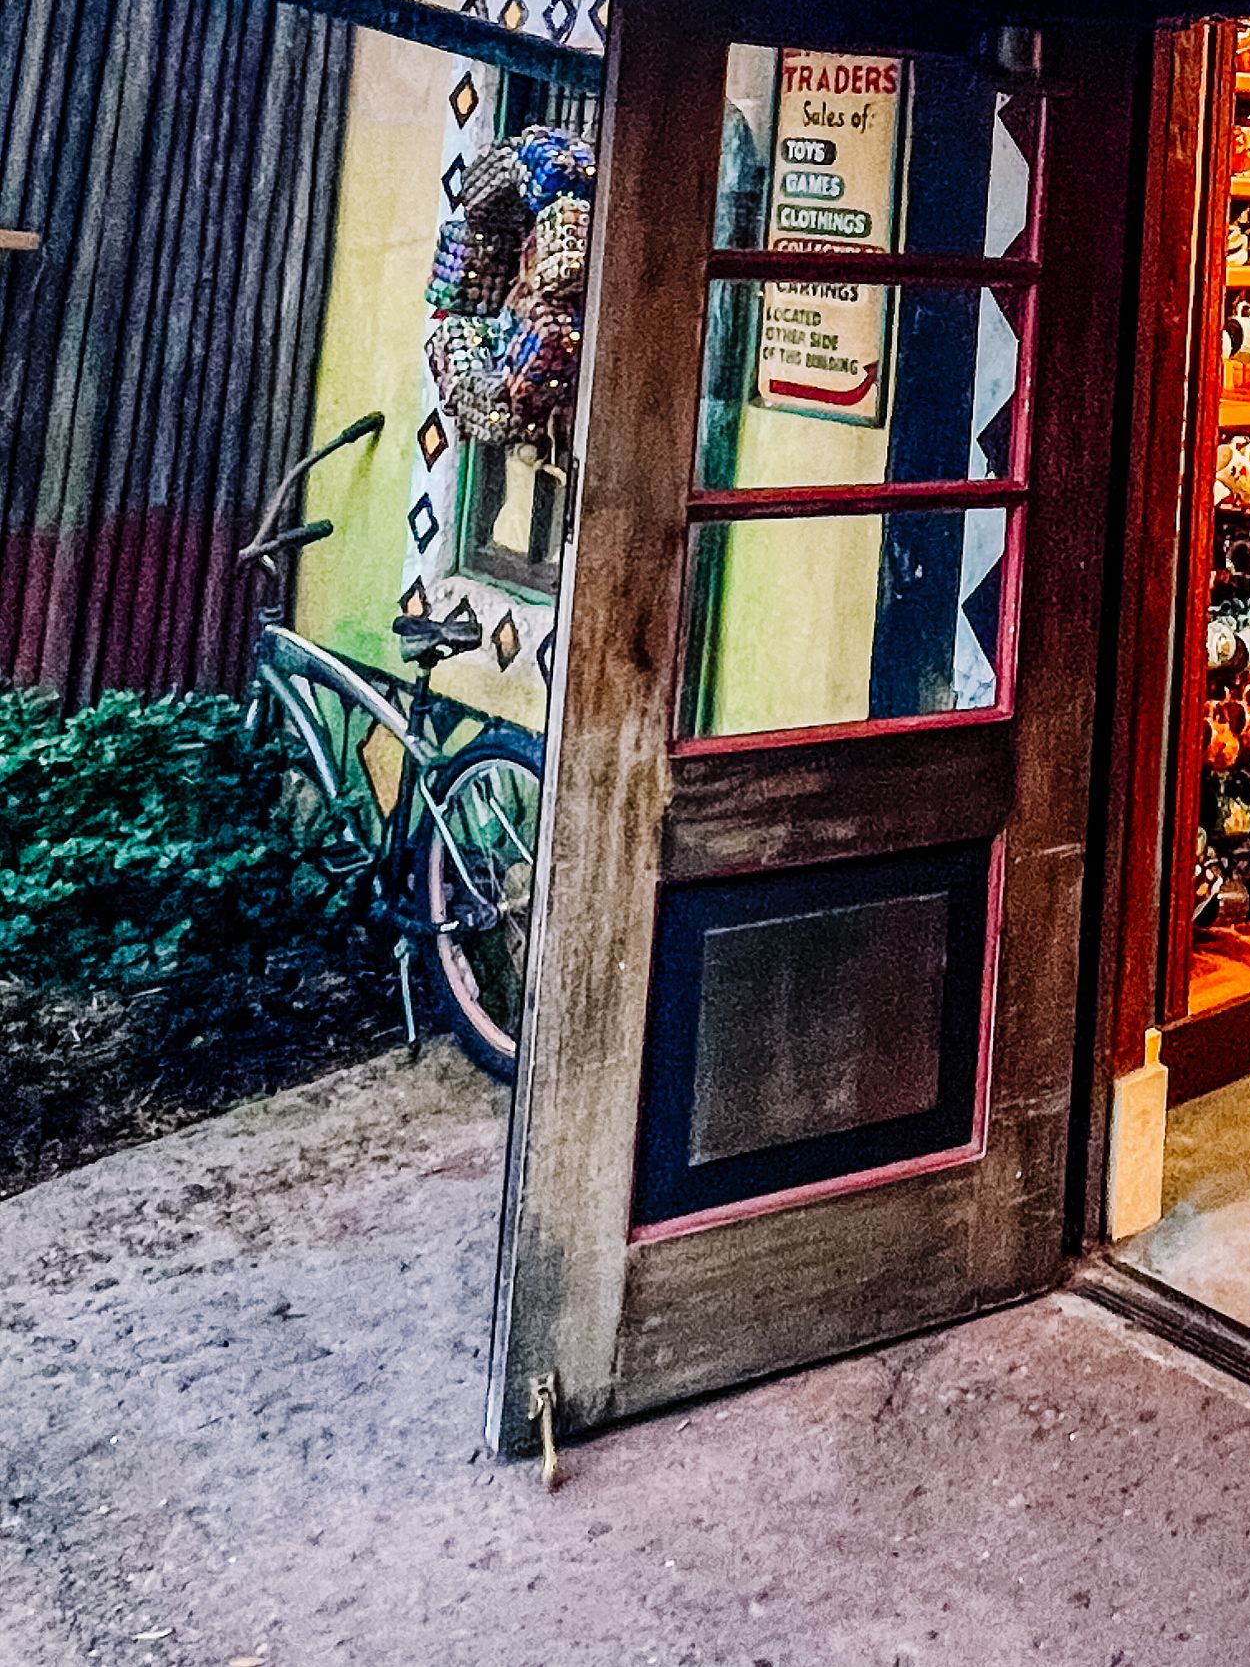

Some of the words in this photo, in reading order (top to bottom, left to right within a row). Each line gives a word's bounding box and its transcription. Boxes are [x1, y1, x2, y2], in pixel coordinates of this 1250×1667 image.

[783, 63, 898, 94] TRADERS
[803, 100, 844, 128] Sales
[786, 140, 825, 162] TOYS
[785, 174, 840, 196] GAMES
[780, 207, 866, 234] CLOTHINGS
